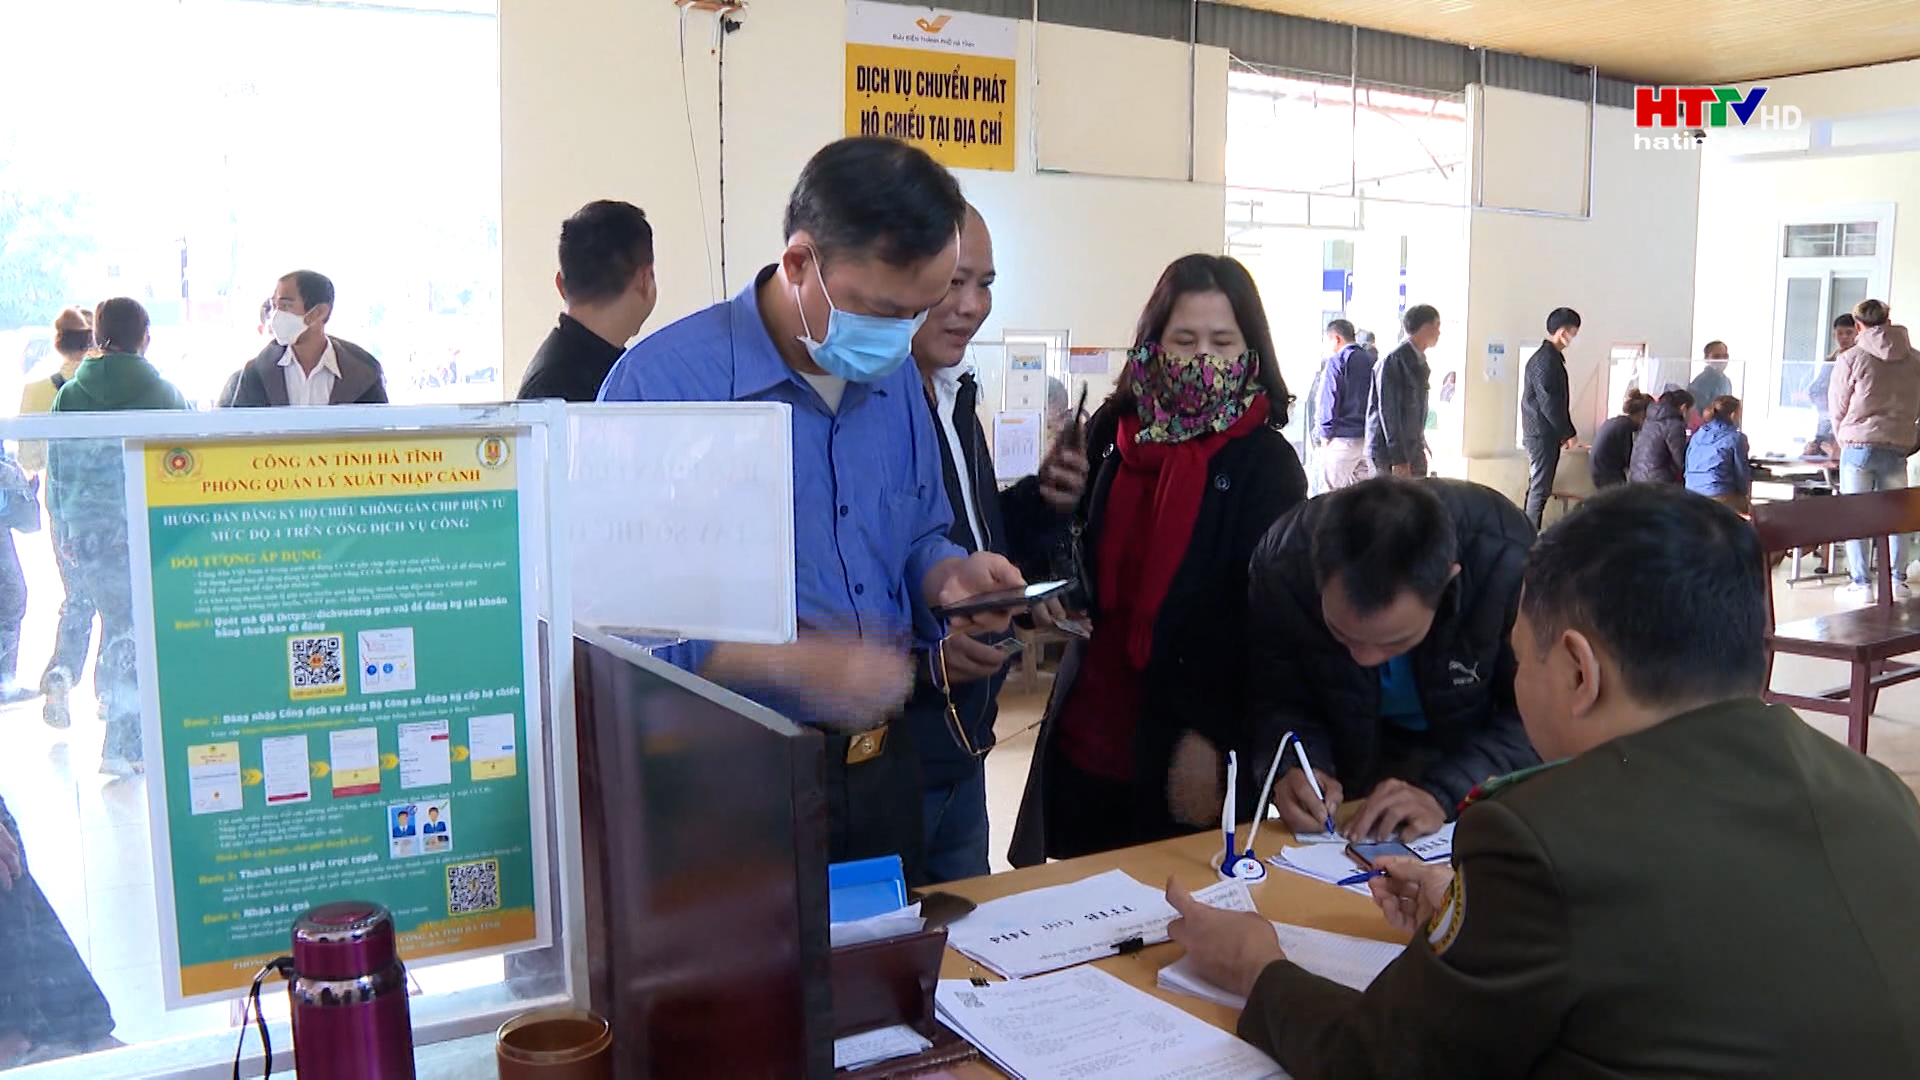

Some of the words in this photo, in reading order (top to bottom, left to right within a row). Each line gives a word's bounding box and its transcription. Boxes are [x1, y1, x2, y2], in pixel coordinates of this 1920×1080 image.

[856, 65, 890, 98] DỊCH
[894, 69, 912, 102] VỤ
[916, 64, 969, 100] CHUYỂN
[974, 74, 1006, 104] PHÁT
[884, 104, 925, 140] CHIẾU
[929, 115, 950, 148] TẠI
[954, 118, 976, 148] ĐỊA
[980, 112, 1002, 146] CHỈ
[252, 454, 300, 470] CÔNG
[306, 455, 328, 468] AN
[336, 450, 372, 466] TỈNH
[378, 450, 399, 464] HÀ
[406, 449, 443, 464] TĨNH
[202, 478, 261, 494] PHÒNG
[266, 476, 312, 492] QUẢN
[318, 472, 336, 488] LÝ
[344, 470, 384, 487] XUẤT
[391, 470, 433, 486] NHẬP
[437, 468, 480, 482] CẢNH
